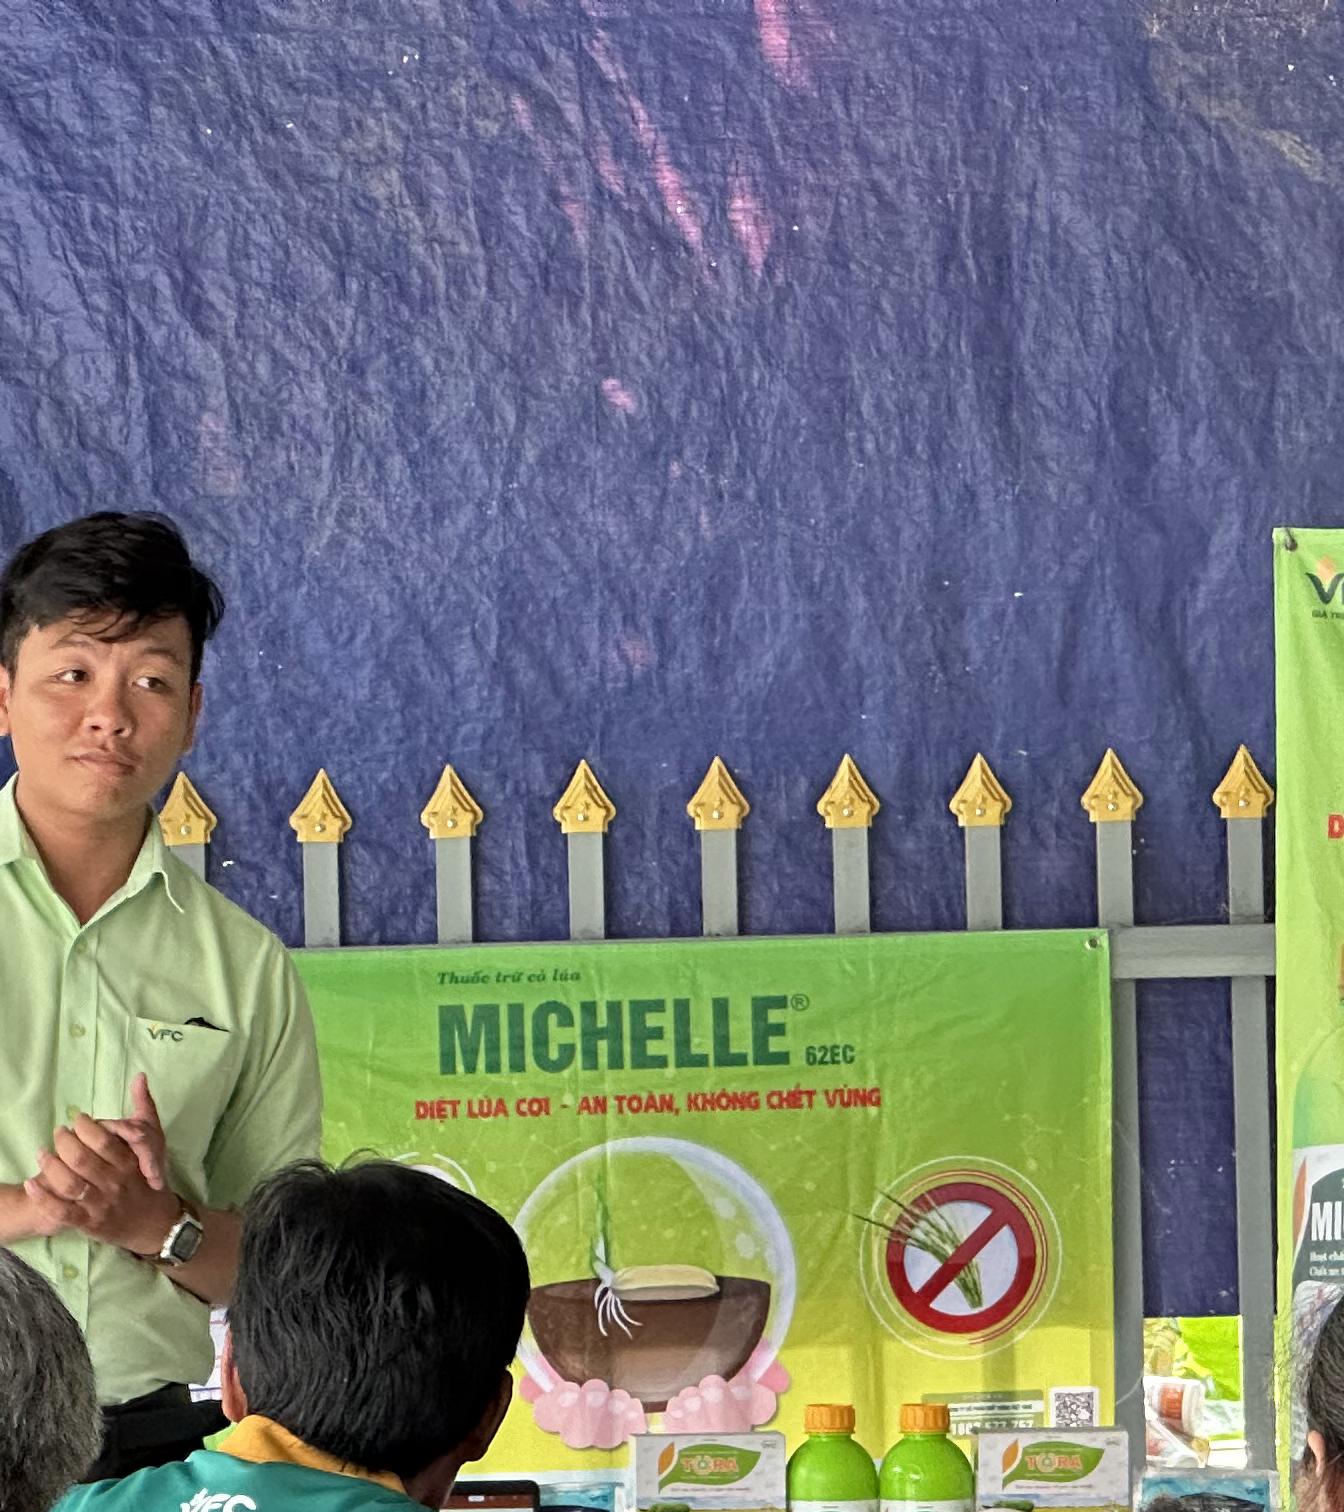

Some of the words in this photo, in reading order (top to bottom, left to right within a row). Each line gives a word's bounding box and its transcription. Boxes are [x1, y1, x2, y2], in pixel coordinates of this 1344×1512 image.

[146, 1027, 184, 1042] VFC
[805, 1044, 856, 1066] 62EC
[415, 1096, 460, 1124] DIỆT
[577, 1095, 608, 1116] AN
[613, 1090, 680, 1117] TOÀN,
[686, 1087, 761, 1113] KHÔNG
[766, 1082, 817, 1111] CHẾT
